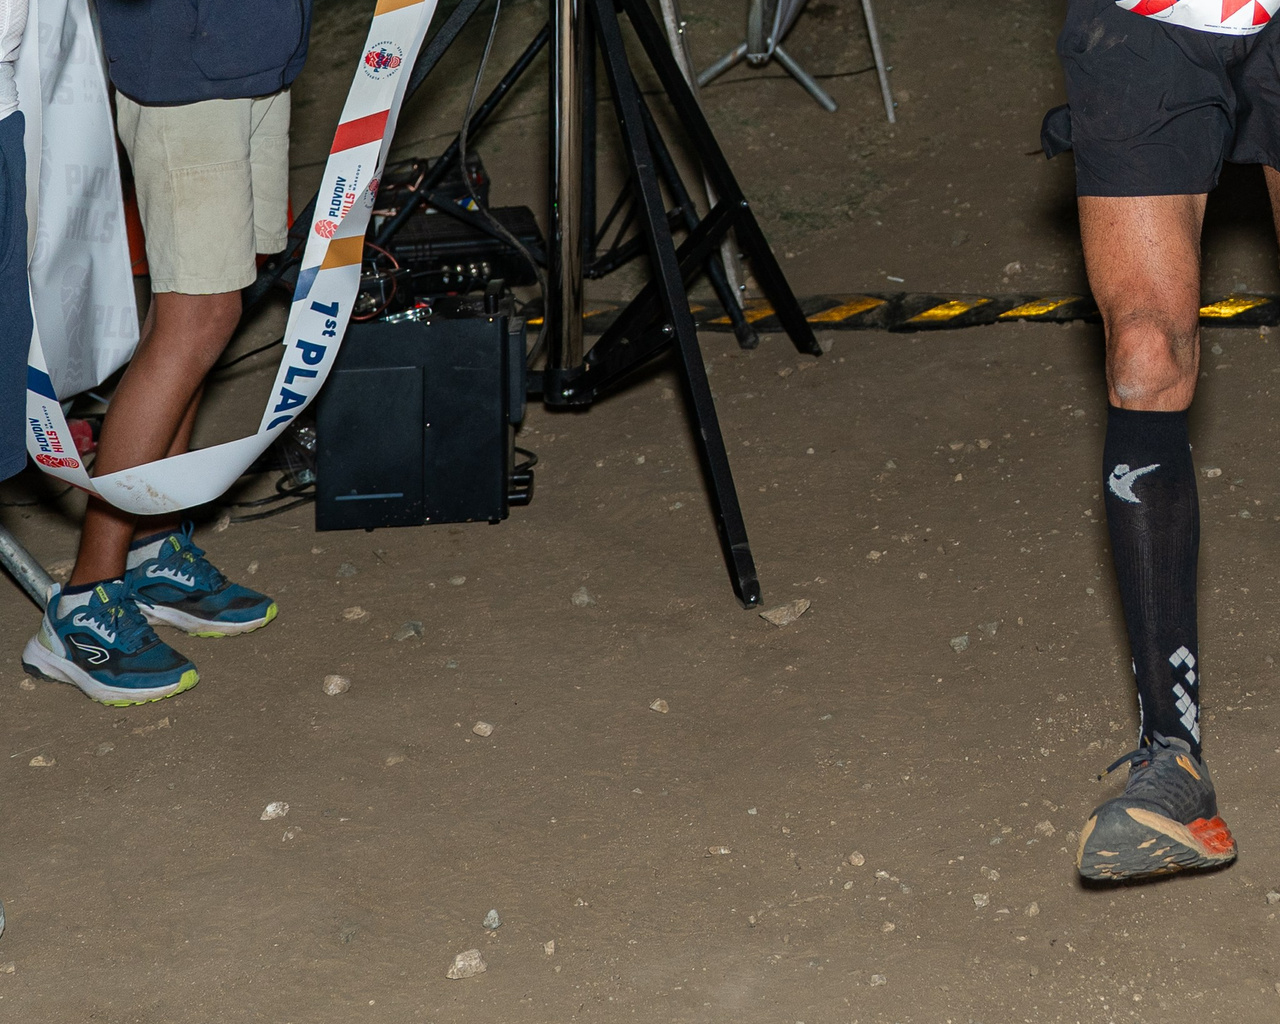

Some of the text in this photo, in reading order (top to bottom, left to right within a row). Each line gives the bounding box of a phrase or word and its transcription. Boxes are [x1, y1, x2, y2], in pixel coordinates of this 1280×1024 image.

[329, 176, 347, 218] PLOVDIV
[310, 300, 339, 338] 1st
[28, 417, 52, 453] PLOVDIV
[46, 430, 64, 453] HILLS
